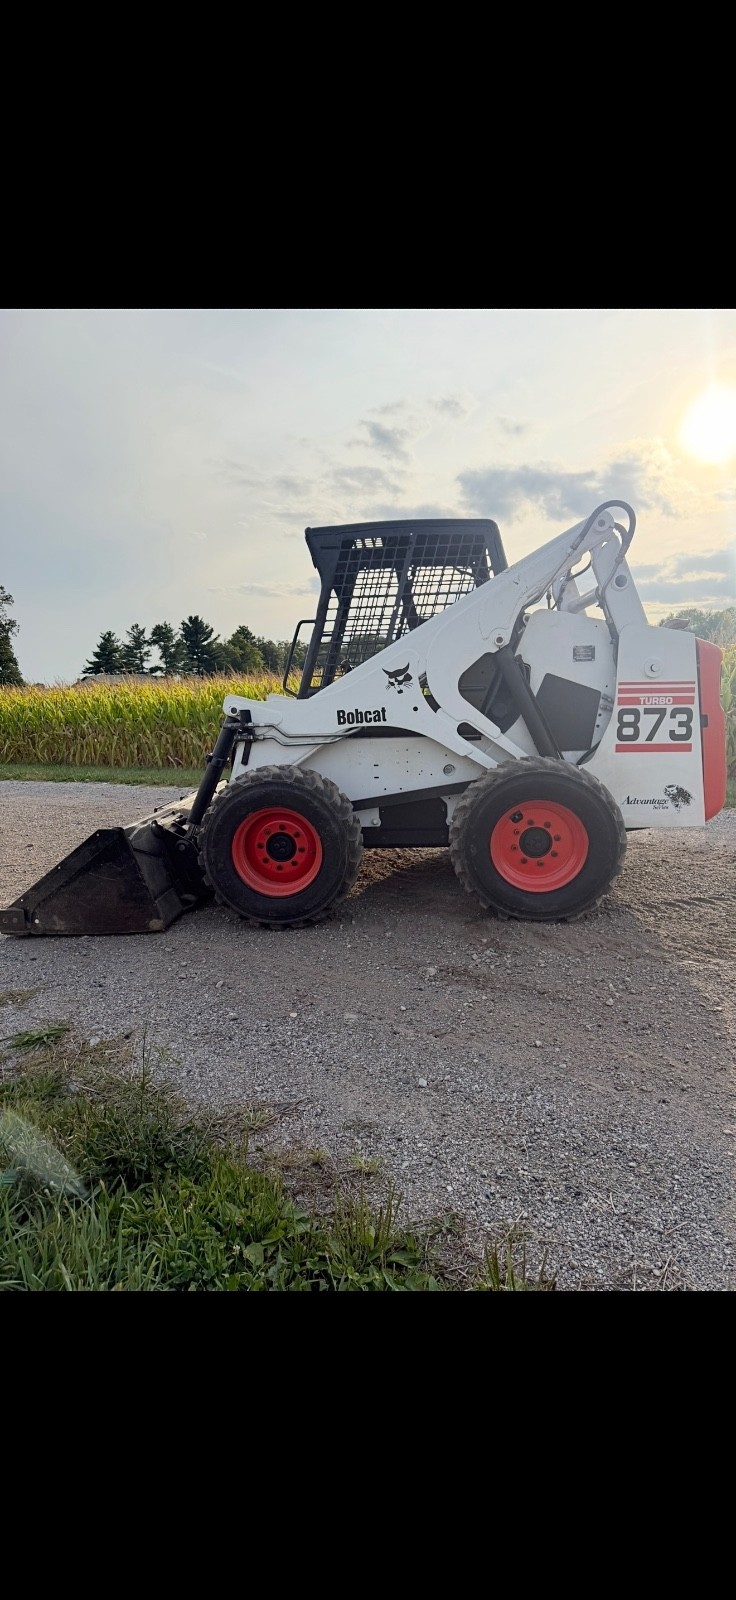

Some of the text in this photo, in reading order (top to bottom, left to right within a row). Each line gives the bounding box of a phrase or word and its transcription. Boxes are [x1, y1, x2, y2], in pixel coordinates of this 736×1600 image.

[639, 696, 673, 705] TURBO
[336, 706, 387, 725] Bobcat
[617, 707, 693, 741] 873
[621, 795, 669, 805] Advantage
